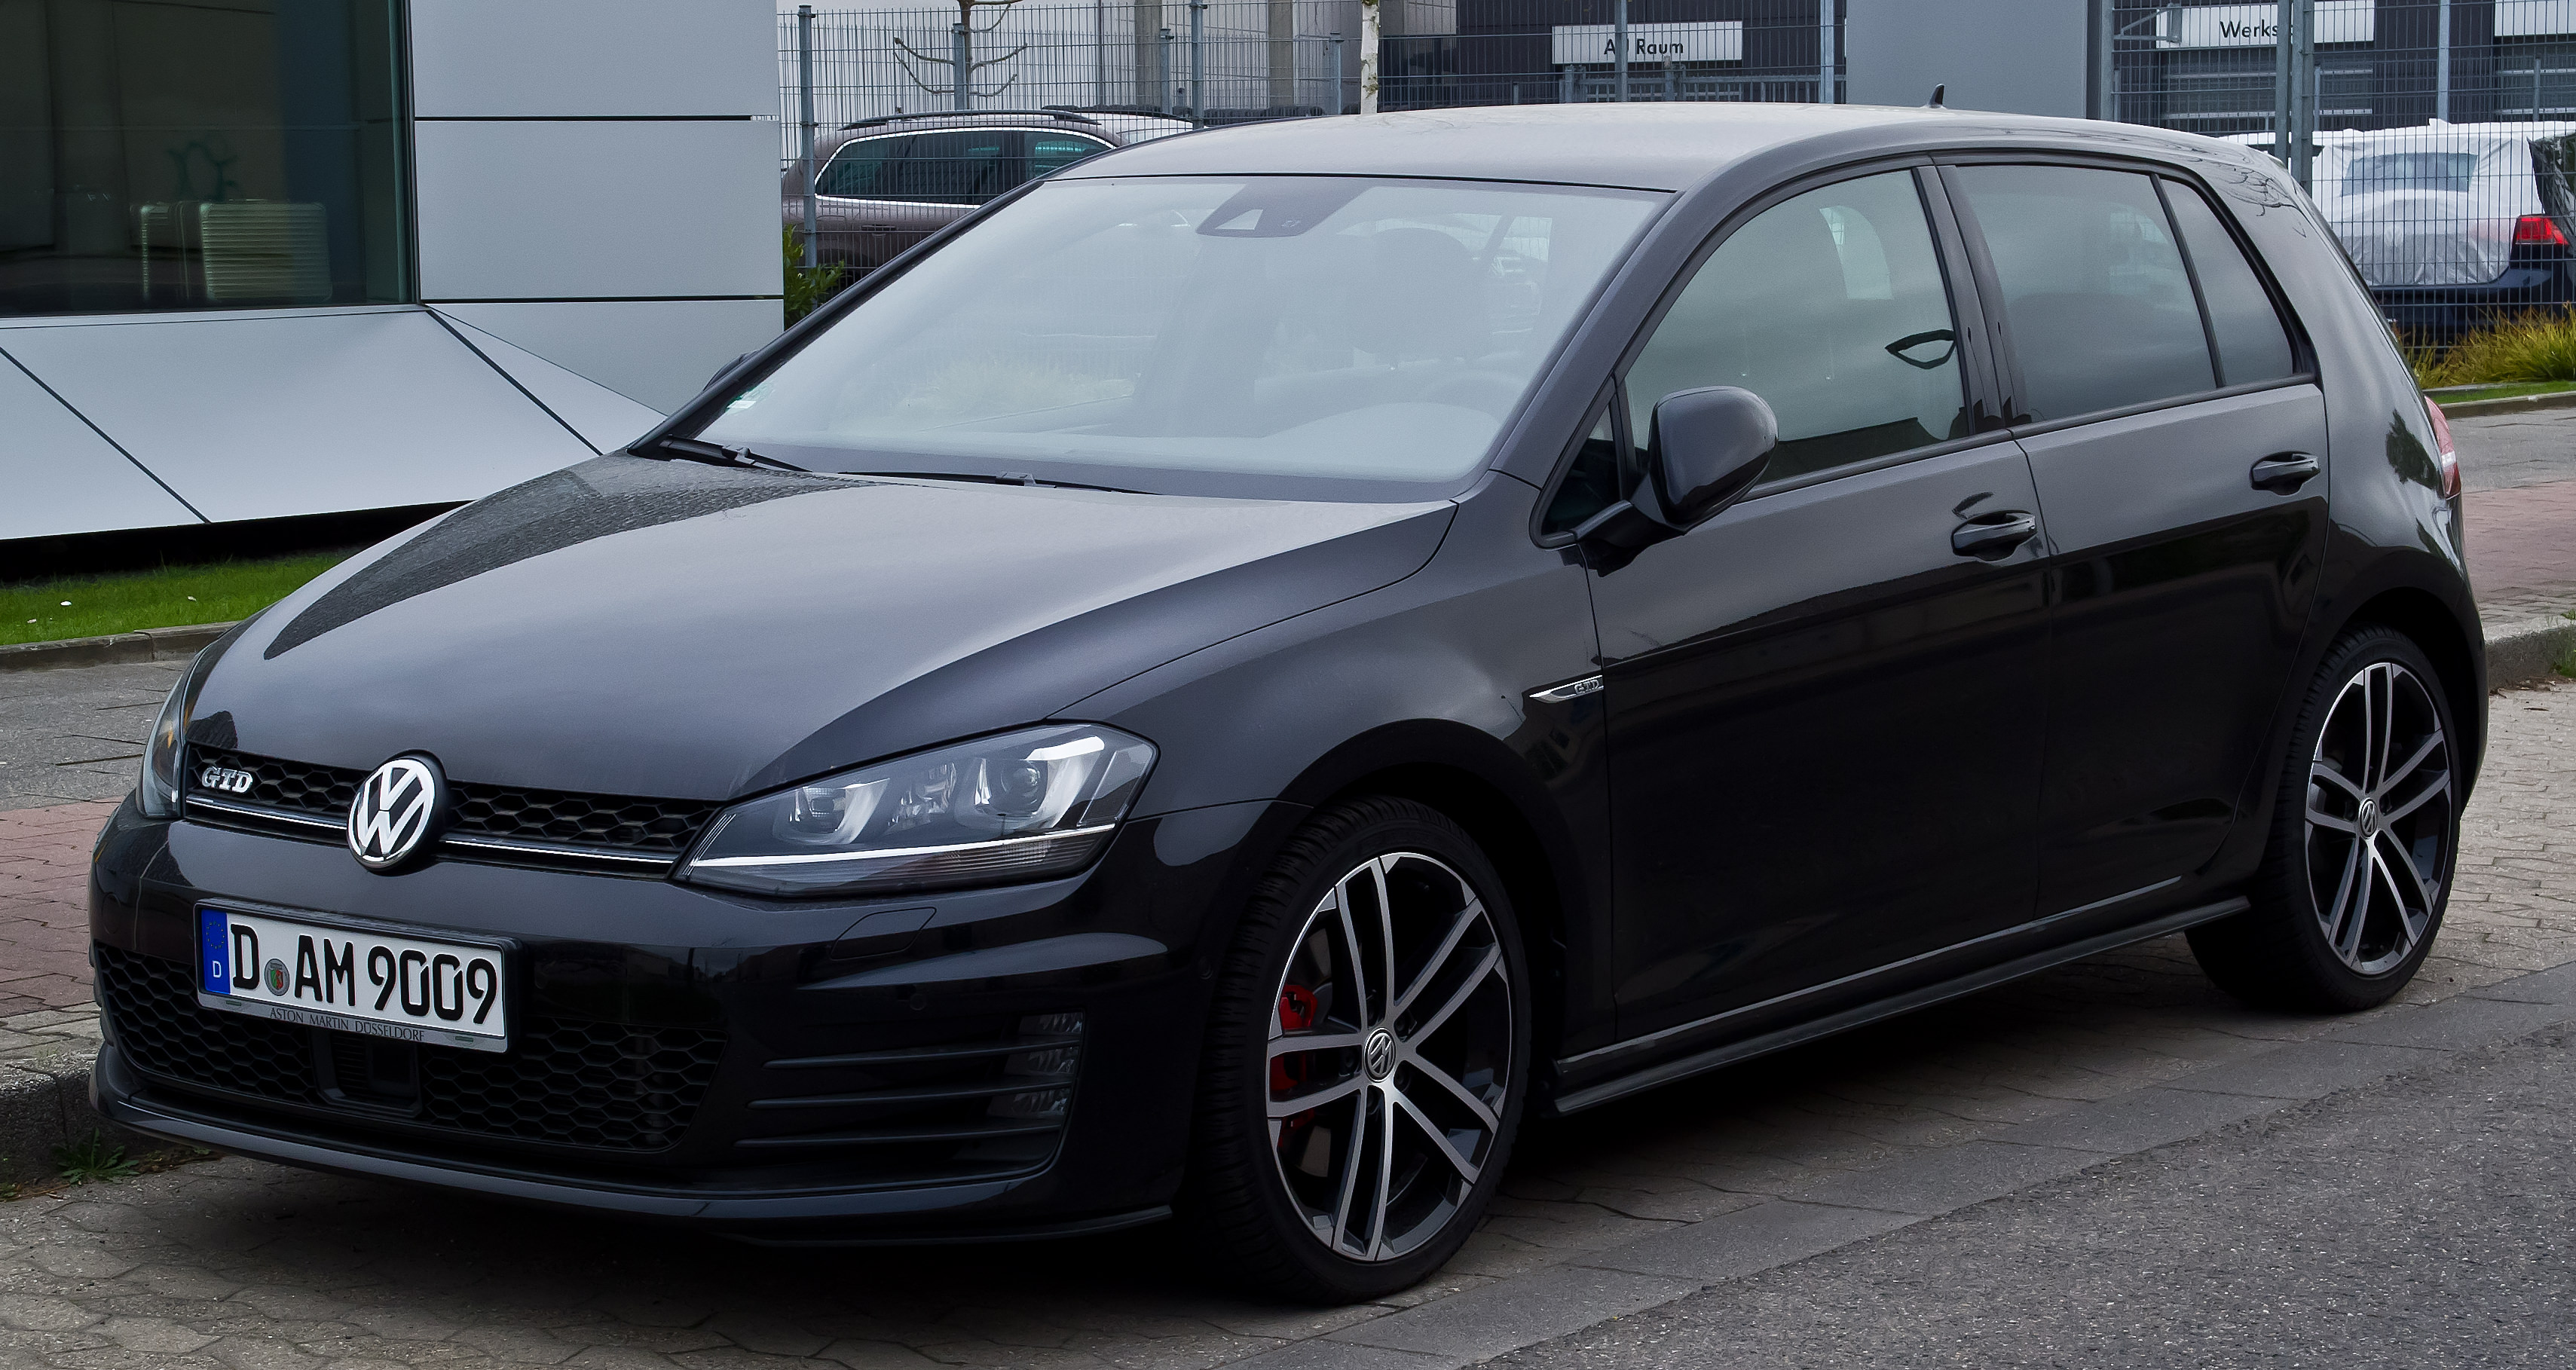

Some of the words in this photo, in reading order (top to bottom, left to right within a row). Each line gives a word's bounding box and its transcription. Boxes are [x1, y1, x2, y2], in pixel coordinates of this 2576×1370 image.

[2220, 19, 2293, 38] Werks
[1604, 38, 1629, 55] A
[1636, 38, 1684, 55] Raum
[1574, 679, 1599, 694] GTD
[201, 766, 253, 794] GTD
[212, 960, 222, 978] D
[230, 923, 259, 989] D
[295, 934, 356, 1007] AM
[367, 945, 497, 1025] 9009
[270, 1007, 304, 1023] ASTON
[309, 1014, 350, 1031] MARTIN
